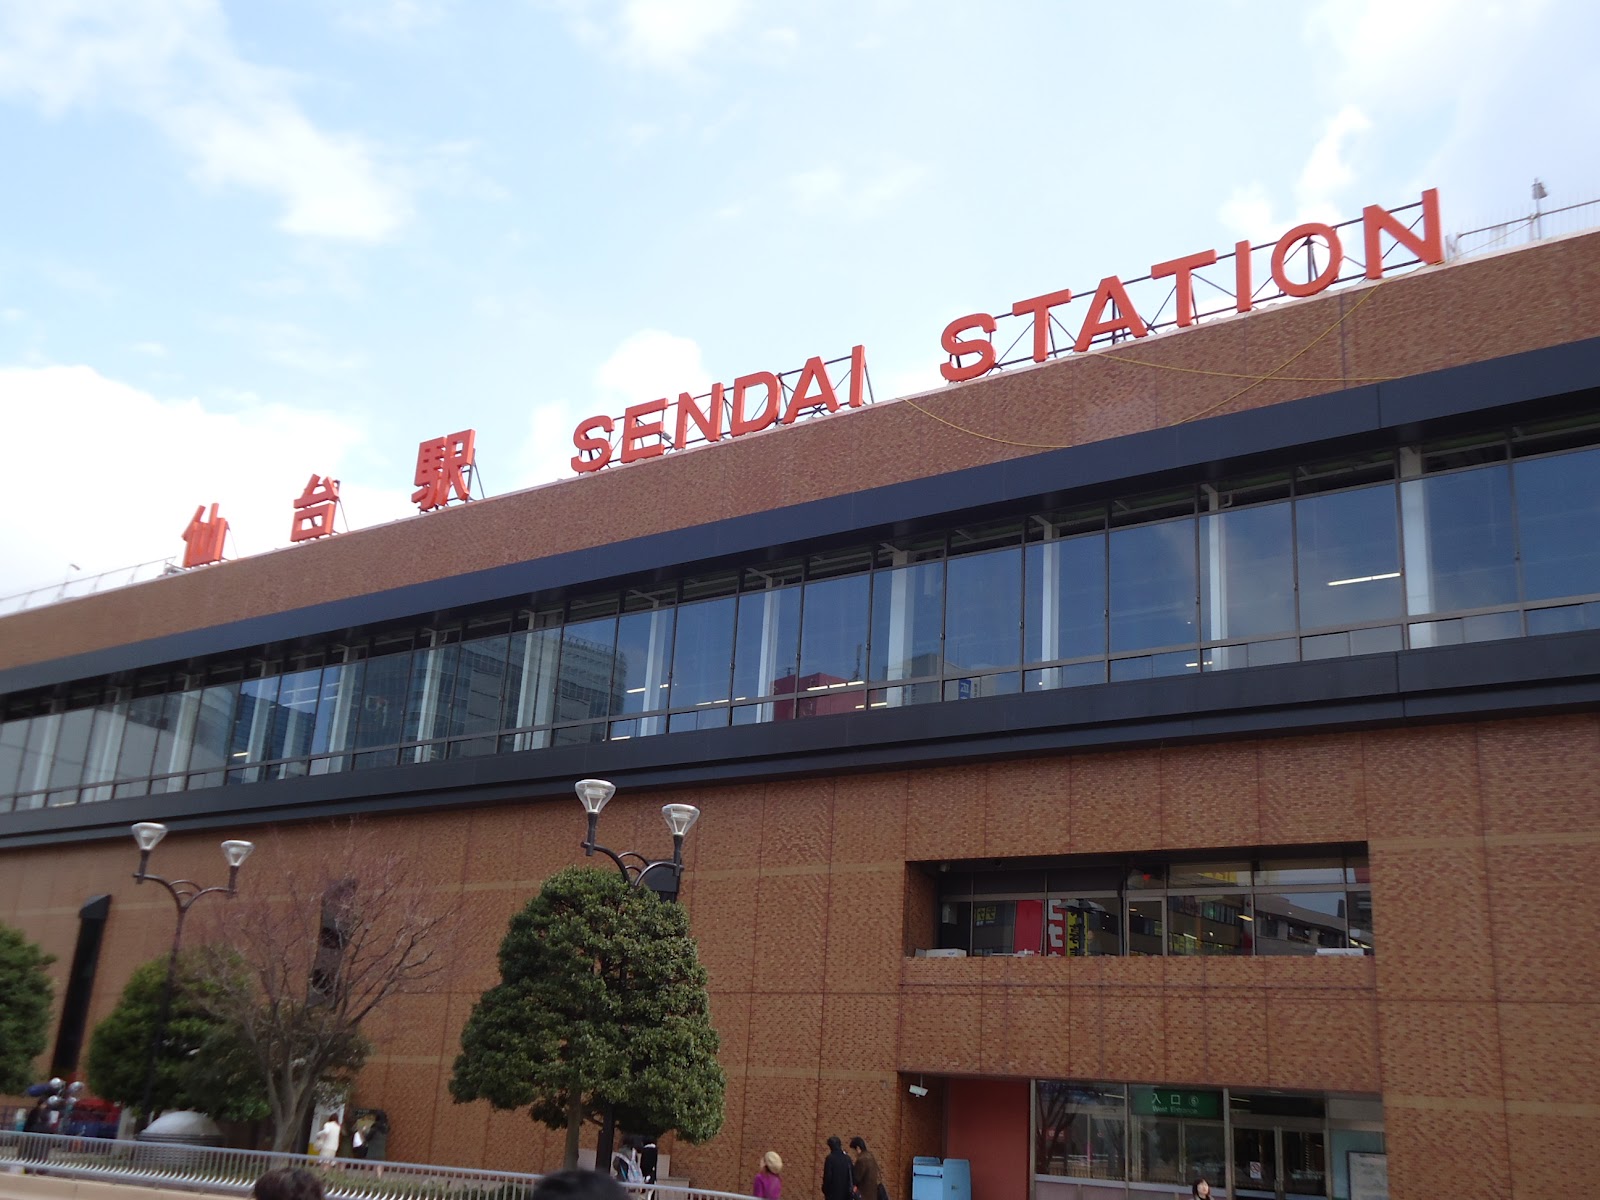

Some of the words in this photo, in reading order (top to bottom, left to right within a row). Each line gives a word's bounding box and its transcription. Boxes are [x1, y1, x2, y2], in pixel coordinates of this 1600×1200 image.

[571, 345, 865, 473] SENDAI
[940, 188, 1444, 382] STATION
[181, 429, 476, 568] 仙台駅
